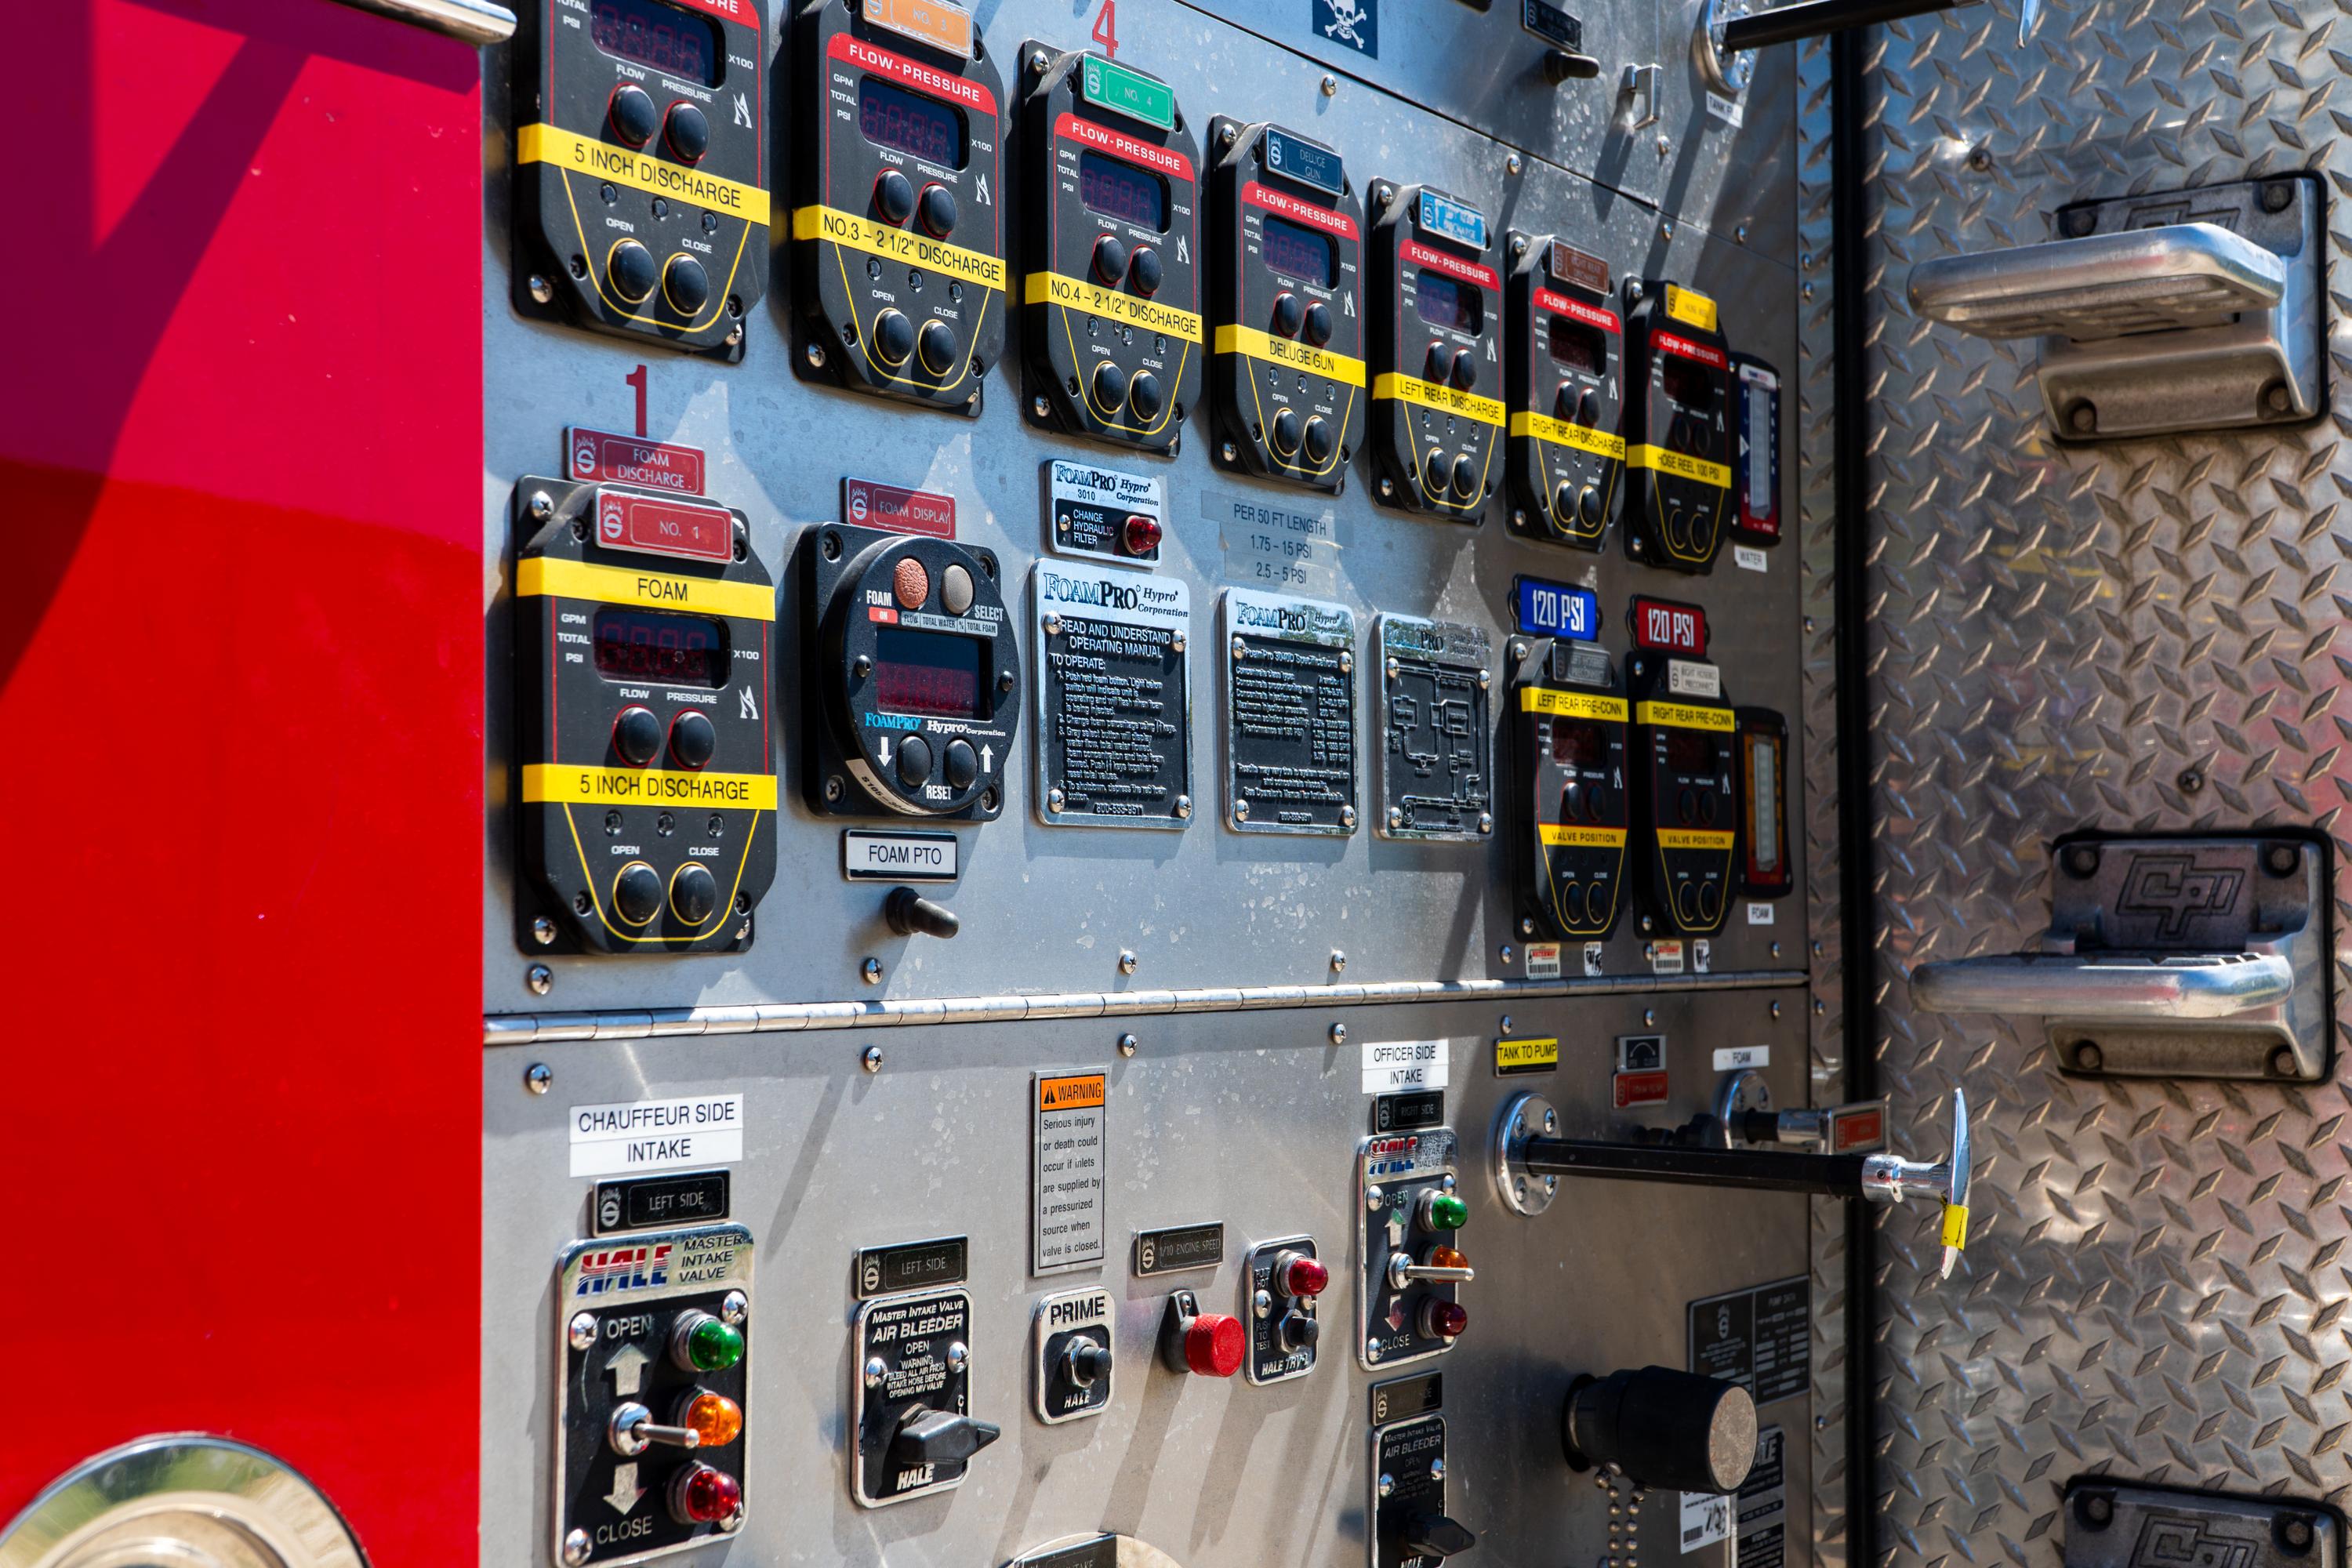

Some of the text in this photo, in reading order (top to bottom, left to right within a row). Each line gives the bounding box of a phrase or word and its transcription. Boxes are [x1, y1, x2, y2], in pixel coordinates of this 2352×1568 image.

[563, 16, 581, 29] PSI
[1092, 0, 1119, 58] 4
[728, 54, 753, 70] X100
[616, 64, 645, 81] FLOW
[662, 79, 711, 103] PRESSURE
[830, 89, 856, 107] TOTAL
[1300, 149, 1327, 169] DELUGE
[575, 143, 741, 209] 5 INCH DISCHARGE
[1305, 166, 1321, 180] GUN
[606, 217, 633, 233] OPEN
[682, 238, 712, 253] CLOSE
[824, 214, 859, 241] NO.3
[877, 230, 884, 248] 2
[919, 242, 1000, 281] DISCHARGE
[1051, 279, 1080, 303] NO.4
[1094, 292, 1102, 308] 2
[1130, 302, 1196, 335] DISCHARGE
[1270, 340, 1334, 372] DELUGE GUN
[626, 365, 647, 437] 1
[1400, 379, 1499, 419] LEFT REAR DISCHARGE
[1532, 418, 1624, 455] RIGHT REAR DISCHARGE
[633, 448, 670, 467] FOAM
[617, 464, 684, 488] DISCHARGE
[1077, 489, 1096, 500] 3010
[1116, 492, 1159, 506] Corporation
[880, 502, 949, 524] FOAM DISPLAY
[1073, 510, 1103, 523] CHANGE
[1234, 504, 1327, 535] PER 50 FT LENGTH
[1073, 521, 1114, 536] HYDRAULIC
[1074, 532, 1098, 545] FILTER
[1250, 535, 1270, 551] 1.75
[1283, 541, 1294, 556] 15
[1296, 543, 1312, 558] PSI
[1740, 551, 1763, 564] WATER
[637, 578, 688, 601] FOAM
[866, 590, 892, 607] FOAM
[561, 613, 586, 625] GPM
[975, 604, 1004, 622] SELECT
[1138, 604, 1189, 617] Corporation
[1533, 590, 1584, 632] 120 PSI
[1061, 619, 1171, 645] READ AND UNDERSTAND
[1648, 608, 1694, 648] 120 PSI
[557, 632, 590, 644] TOTAL
[734, 650, 759, 660] X100
[1069, 636, 1163, 659] OPERATING MANUAL
[566, 652, 583, 663] PSI
[620, 688, 649, 699] FLOW
[666, 691, 717, 705] PRESSURE
[1538, 695, 1621, 716] LEFT REAR PRE-CONN
[1653, 706, 1732, 726] RIGHT REAR PRE-CONN
[580, 775, 749, 800] 5 INCH DISCHARGE
[927, 786, 952, 800] RESET
[1552, 832, 1617, 844] VALVE POSITION
[1668, 836, 1725, 846] VALVE POSITION
[612, 845, 640, 855] OPEN
[689, 847, 719, 856] CLOSE
[869, 845, 942, 865] FOAM PTO
[1751, 906, 1769, 919] FOAM
[1374, 1045, 1436, 1062] OFFICER SIDE
[1497, 1043, 1557, 1061] TANK TO PUMP
[1733, 1051, 1751, 1064] FOAM
[1391, 1069, 1422, 1085] INTAKE
[1058, 1082, 1102, 1102] WARNING
[579, 1102, 735, 1132] CHAUFFEUR SIDE
[1044, 1116, 1095, 1130] Serious injury
[628, 1138, 691, 1162] INTAKE
[1044, 1135, 1098, 1151] or death could
[1044, 1156, 1094, 1173] occur if inlets
[1044, 1177, 1101, 1194] are supplied by
[649, 1192, 704, 1211] LEFT SIDE
[1043, 1198, 1093, 1215] a pressurized
[1385, 1190, 1409, 1207] OPEN
[1043, 1221, 1090, 1236] source when
[1043, 1238, 1100, 1257] valve is closed.
[576, 1234, 744, 1298] HALE MASTER
[681, 1250, 734, 1267] INTAKE
[902, 1257, 946, 1275] LEFT SIDE
[680, 1267, 725, 1283] VALVE
[1256, 1268, 1270, 1277] PUMP
[1257, 1278, 1268, 1288] HOT
[872, 1301, 964, 1324] MASTER INTAKE VALVE
[1051, 1295, 1105, 1326] PRIME
[607, 1316, 652, 1339] OPEN
[872, 1313, 963, 1344] AIR BLEEDER
[906, 1341, 929, 1355] OPEN
[1256, 1341, 1270, 1351] TEST
[1381, 1334, 1410, 1352] CLOSE
[901, 1355, 934, 1370] WARNING
[887, 1371, 946, 1390] INTAKE HOSE BEFORE
[888, 1372, 907, 1381] BLEED
[908, 1367, 918, 1377] ALL
[919, 1366, 928, 1375] AIR
[1065, 1388, 1090, 1409] HALE
[1385, 1434, 1441, 1458] AIR BLEEDER
[897, 1464, 935, 1490] HALE
[597, 1515, 653, 1544] CLOSE
